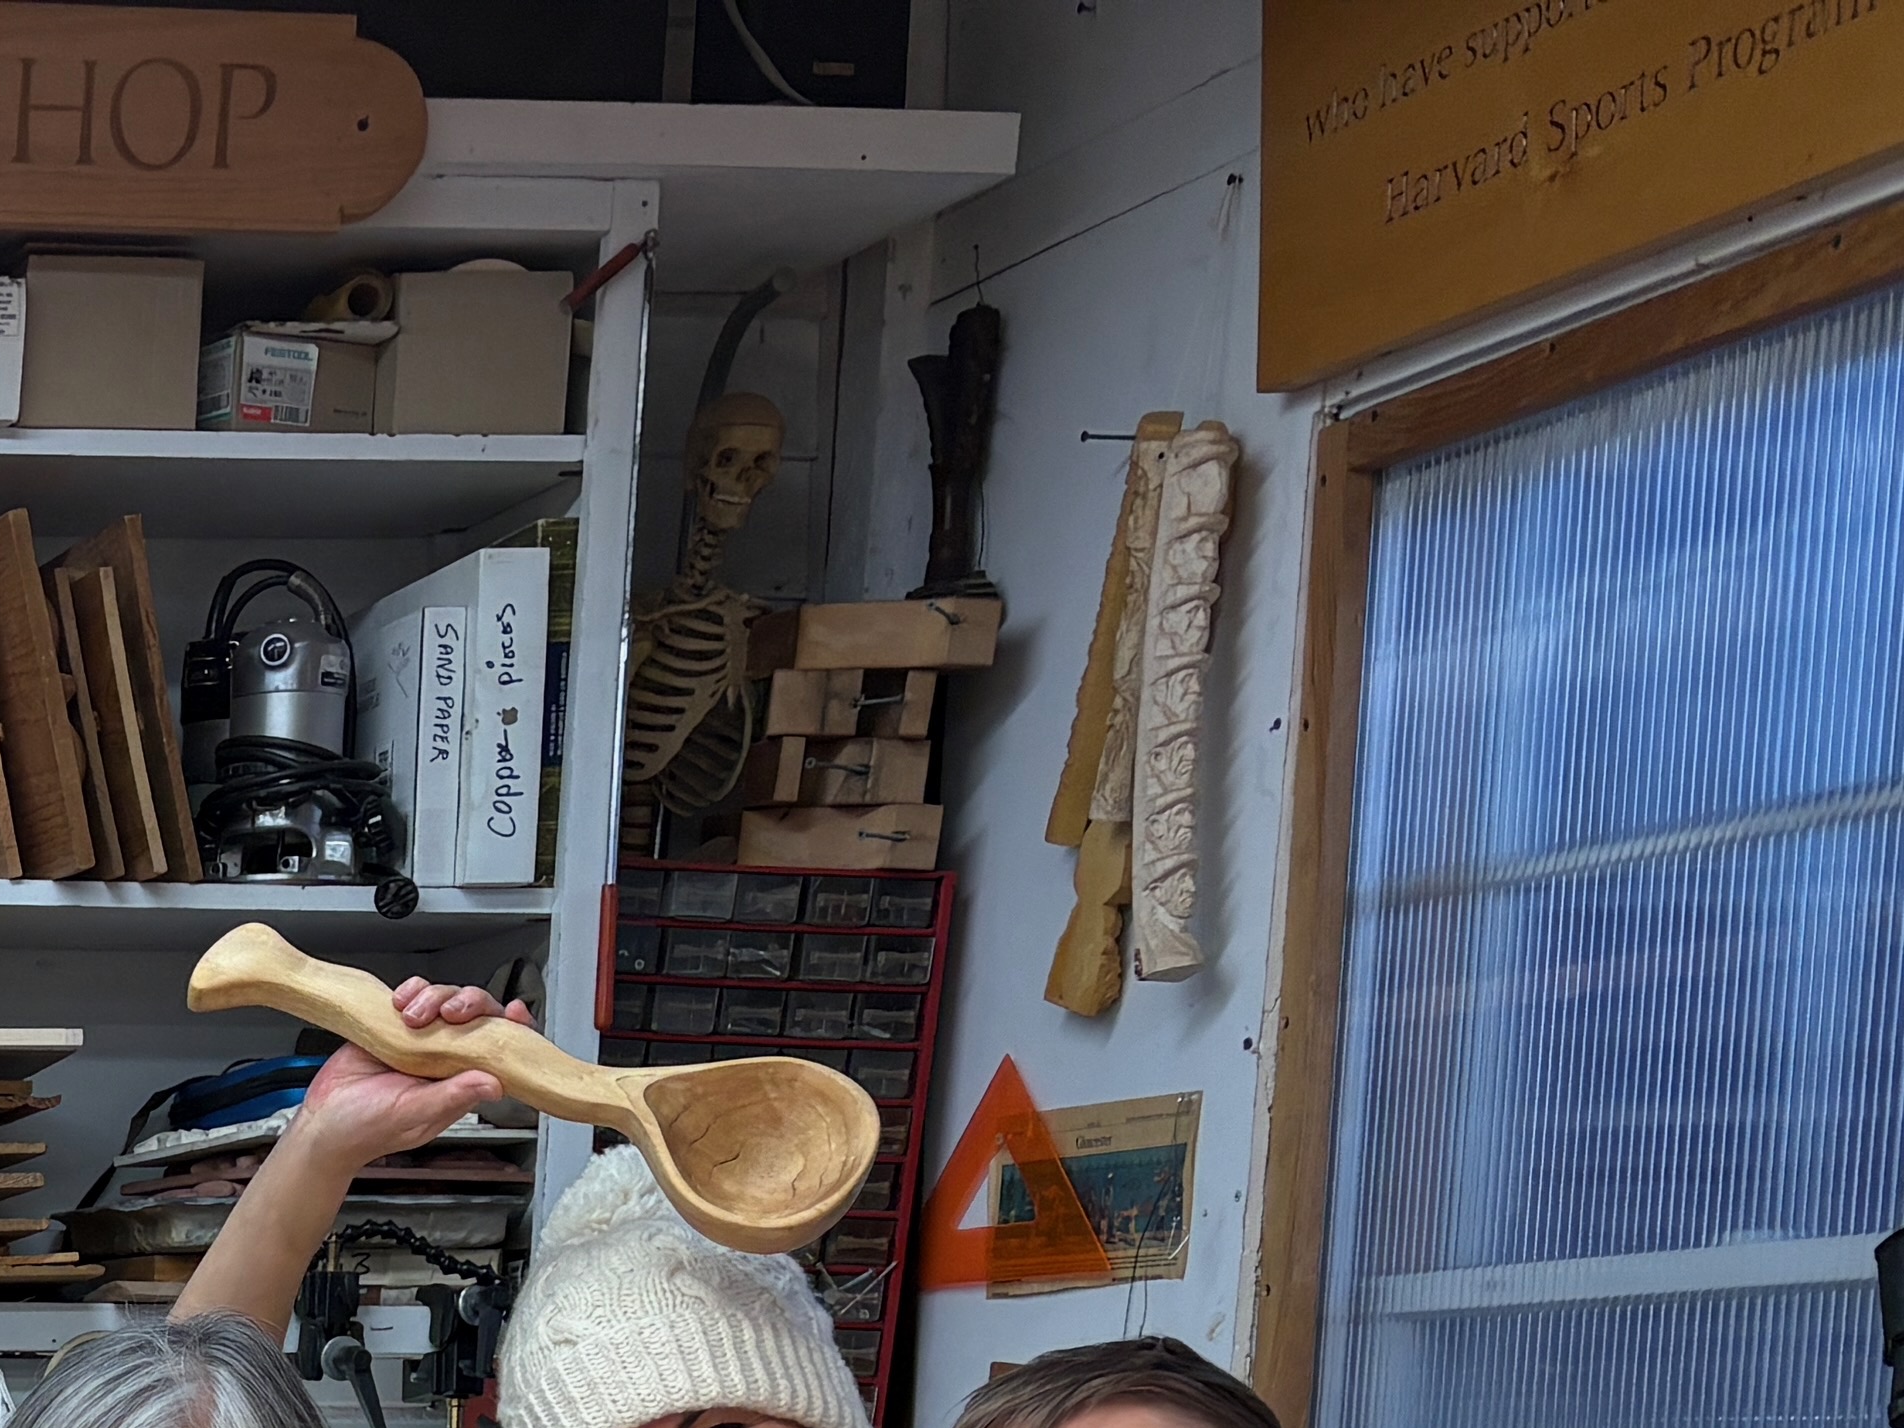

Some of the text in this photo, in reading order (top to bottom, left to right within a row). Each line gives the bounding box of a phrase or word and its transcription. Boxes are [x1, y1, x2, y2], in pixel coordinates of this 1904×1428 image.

[1304, 43, 1456, 144] who have
[1384, 110, 1531, 225] Harvard
[1546, 63, 1671, 163] Sports
[264, 346, 314, 362] FESTOOL
[429, 623, 460, 763] SAND PAPER
